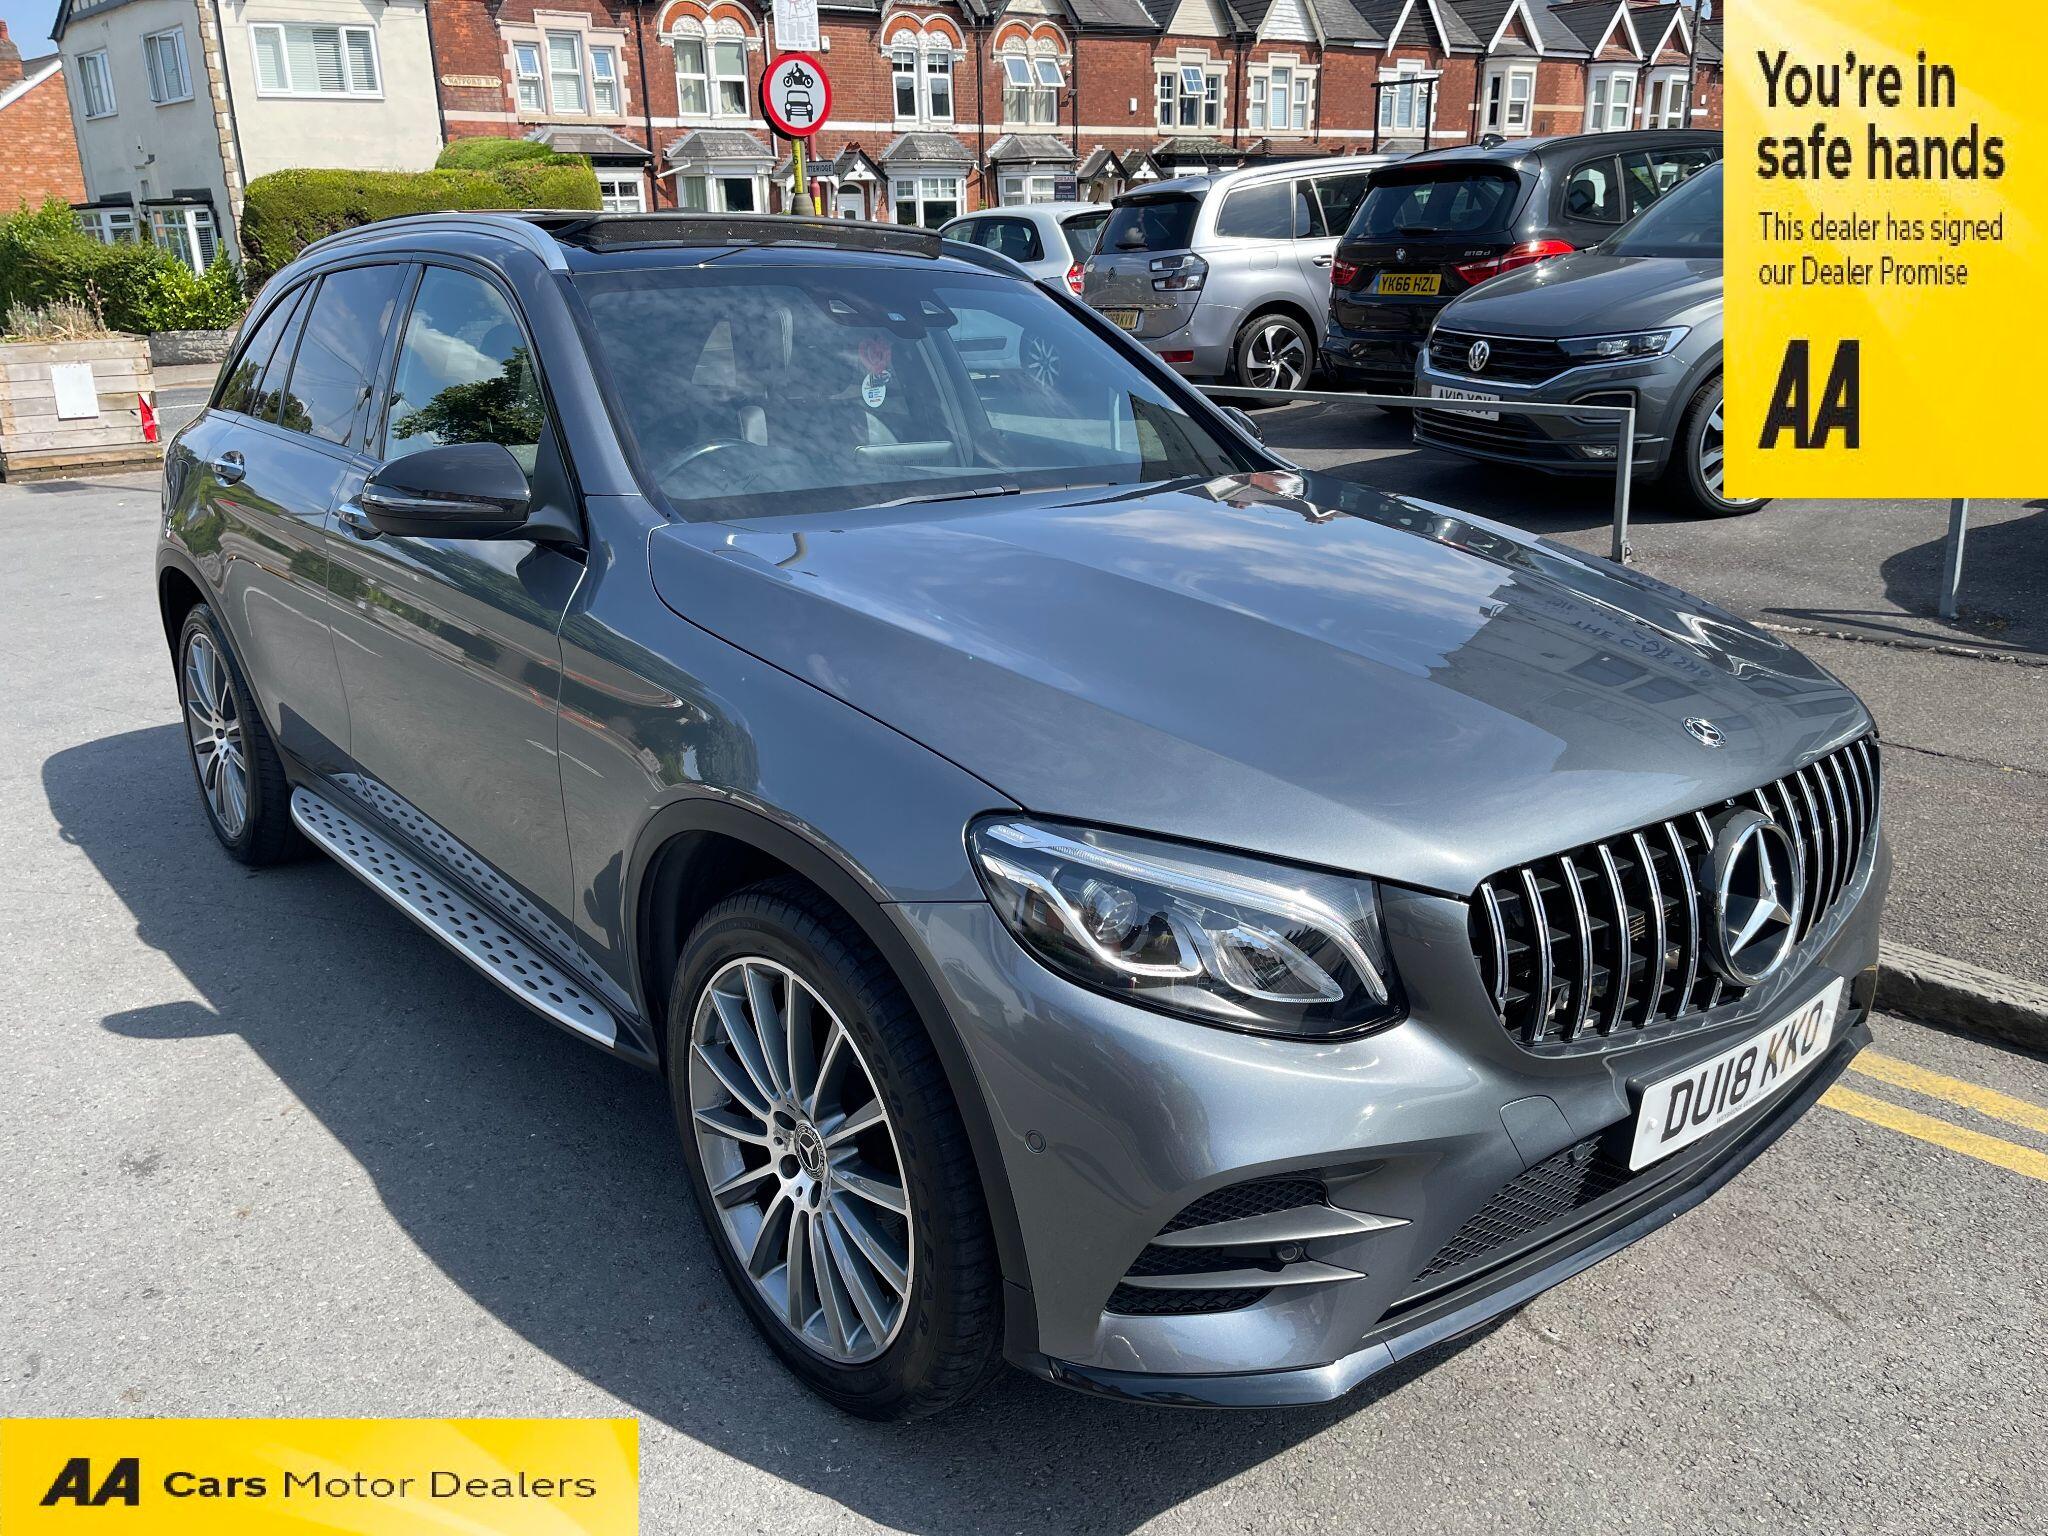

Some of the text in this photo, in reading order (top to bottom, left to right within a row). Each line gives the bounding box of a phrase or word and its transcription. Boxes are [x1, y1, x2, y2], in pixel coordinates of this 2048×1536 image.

[1381, 276, 1436, 292] YK66 HZL
[1660, 1000, 1824, 1143] DU18 KKO
